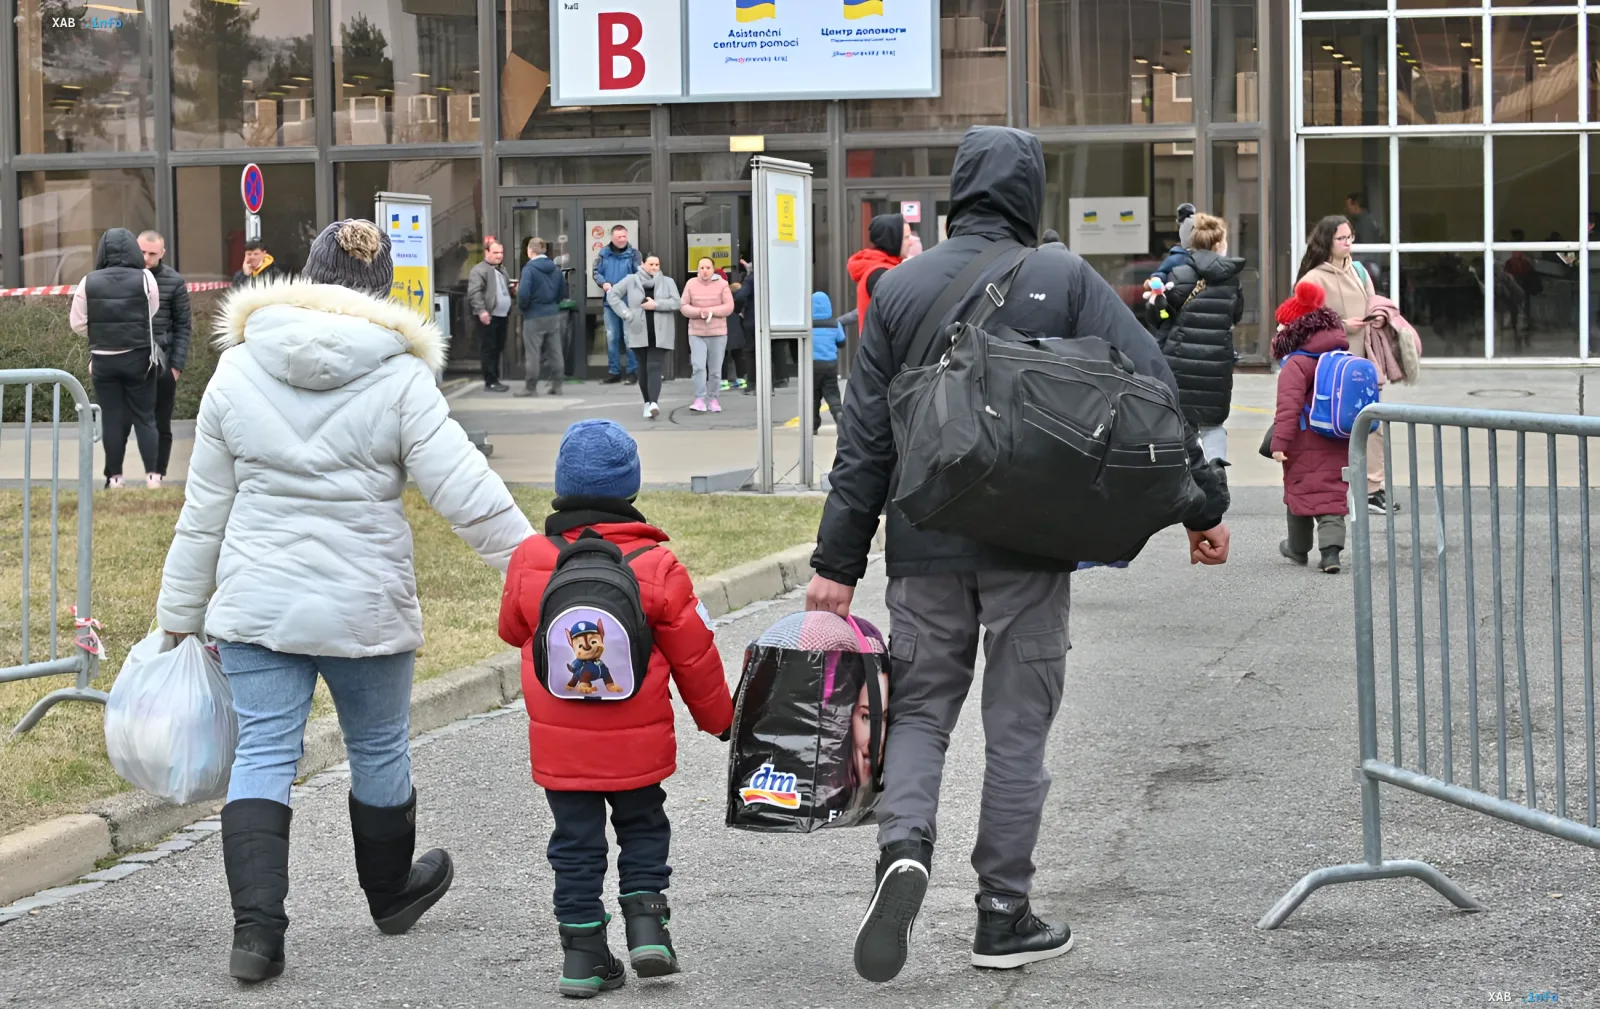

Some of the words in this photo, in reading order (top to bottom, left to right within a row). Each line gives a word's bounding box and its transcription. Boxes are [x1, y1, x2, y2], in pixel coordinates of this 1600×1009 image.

[598, 12, 646, 90] B
[713, 40, 758, 49] centrum
[751, 766, 795, 792] dm
